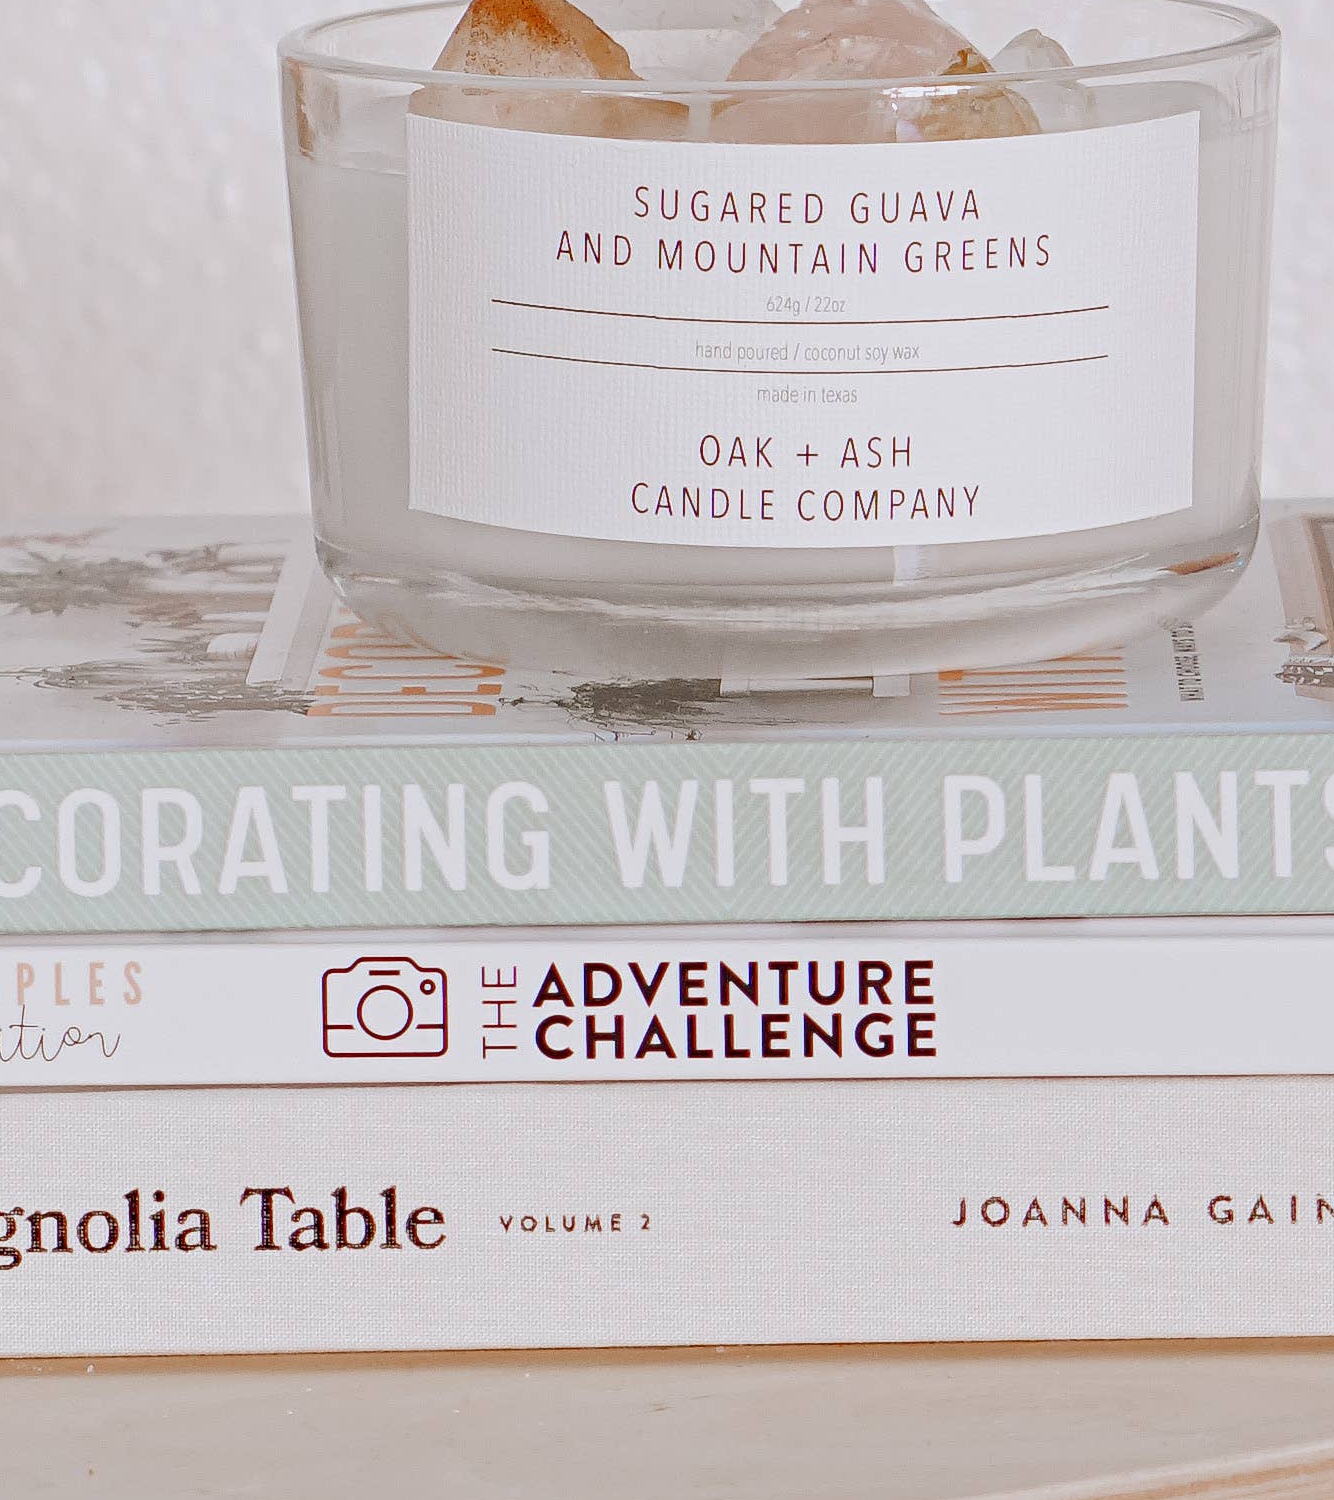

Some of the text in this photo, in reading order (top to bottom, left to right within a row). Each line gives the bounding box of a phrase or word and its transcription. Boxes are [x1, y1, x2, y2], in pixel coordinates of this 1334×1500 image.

[633, 185, 980, 225] SUGARED GUAVA
[556, 230, 1050, 275] AND MOUNTAIN GREENS
[765, 295, 801, 317] 624g
[813, 295, 846, 313] 22oz
[695, 339, 732, 360] hand
[737, 341, 788, 365] poured
[804, 344, 861, 362] coconut
[864, 346, 889, 366] soy
[892, 345, 920, 361] wax
[757, 383, 858, 404] made in texas
[699, 434, 911, 469] OAK + ASH
[631, 482, 979, 522] CANDLE COMPANY
[603, 774, 885, 890] WITH
[480, 959, 935, 1060] THE ADVENTURE
[534, 1012, 937, 1061] CHALLENGE
[239, 1184, 447, 1252] Table
[499, 1213, 622, 1234] VOLUME
[640, 1213, 650, 1231] 2
[950, 1193, 1170, 1229] JOANNA
